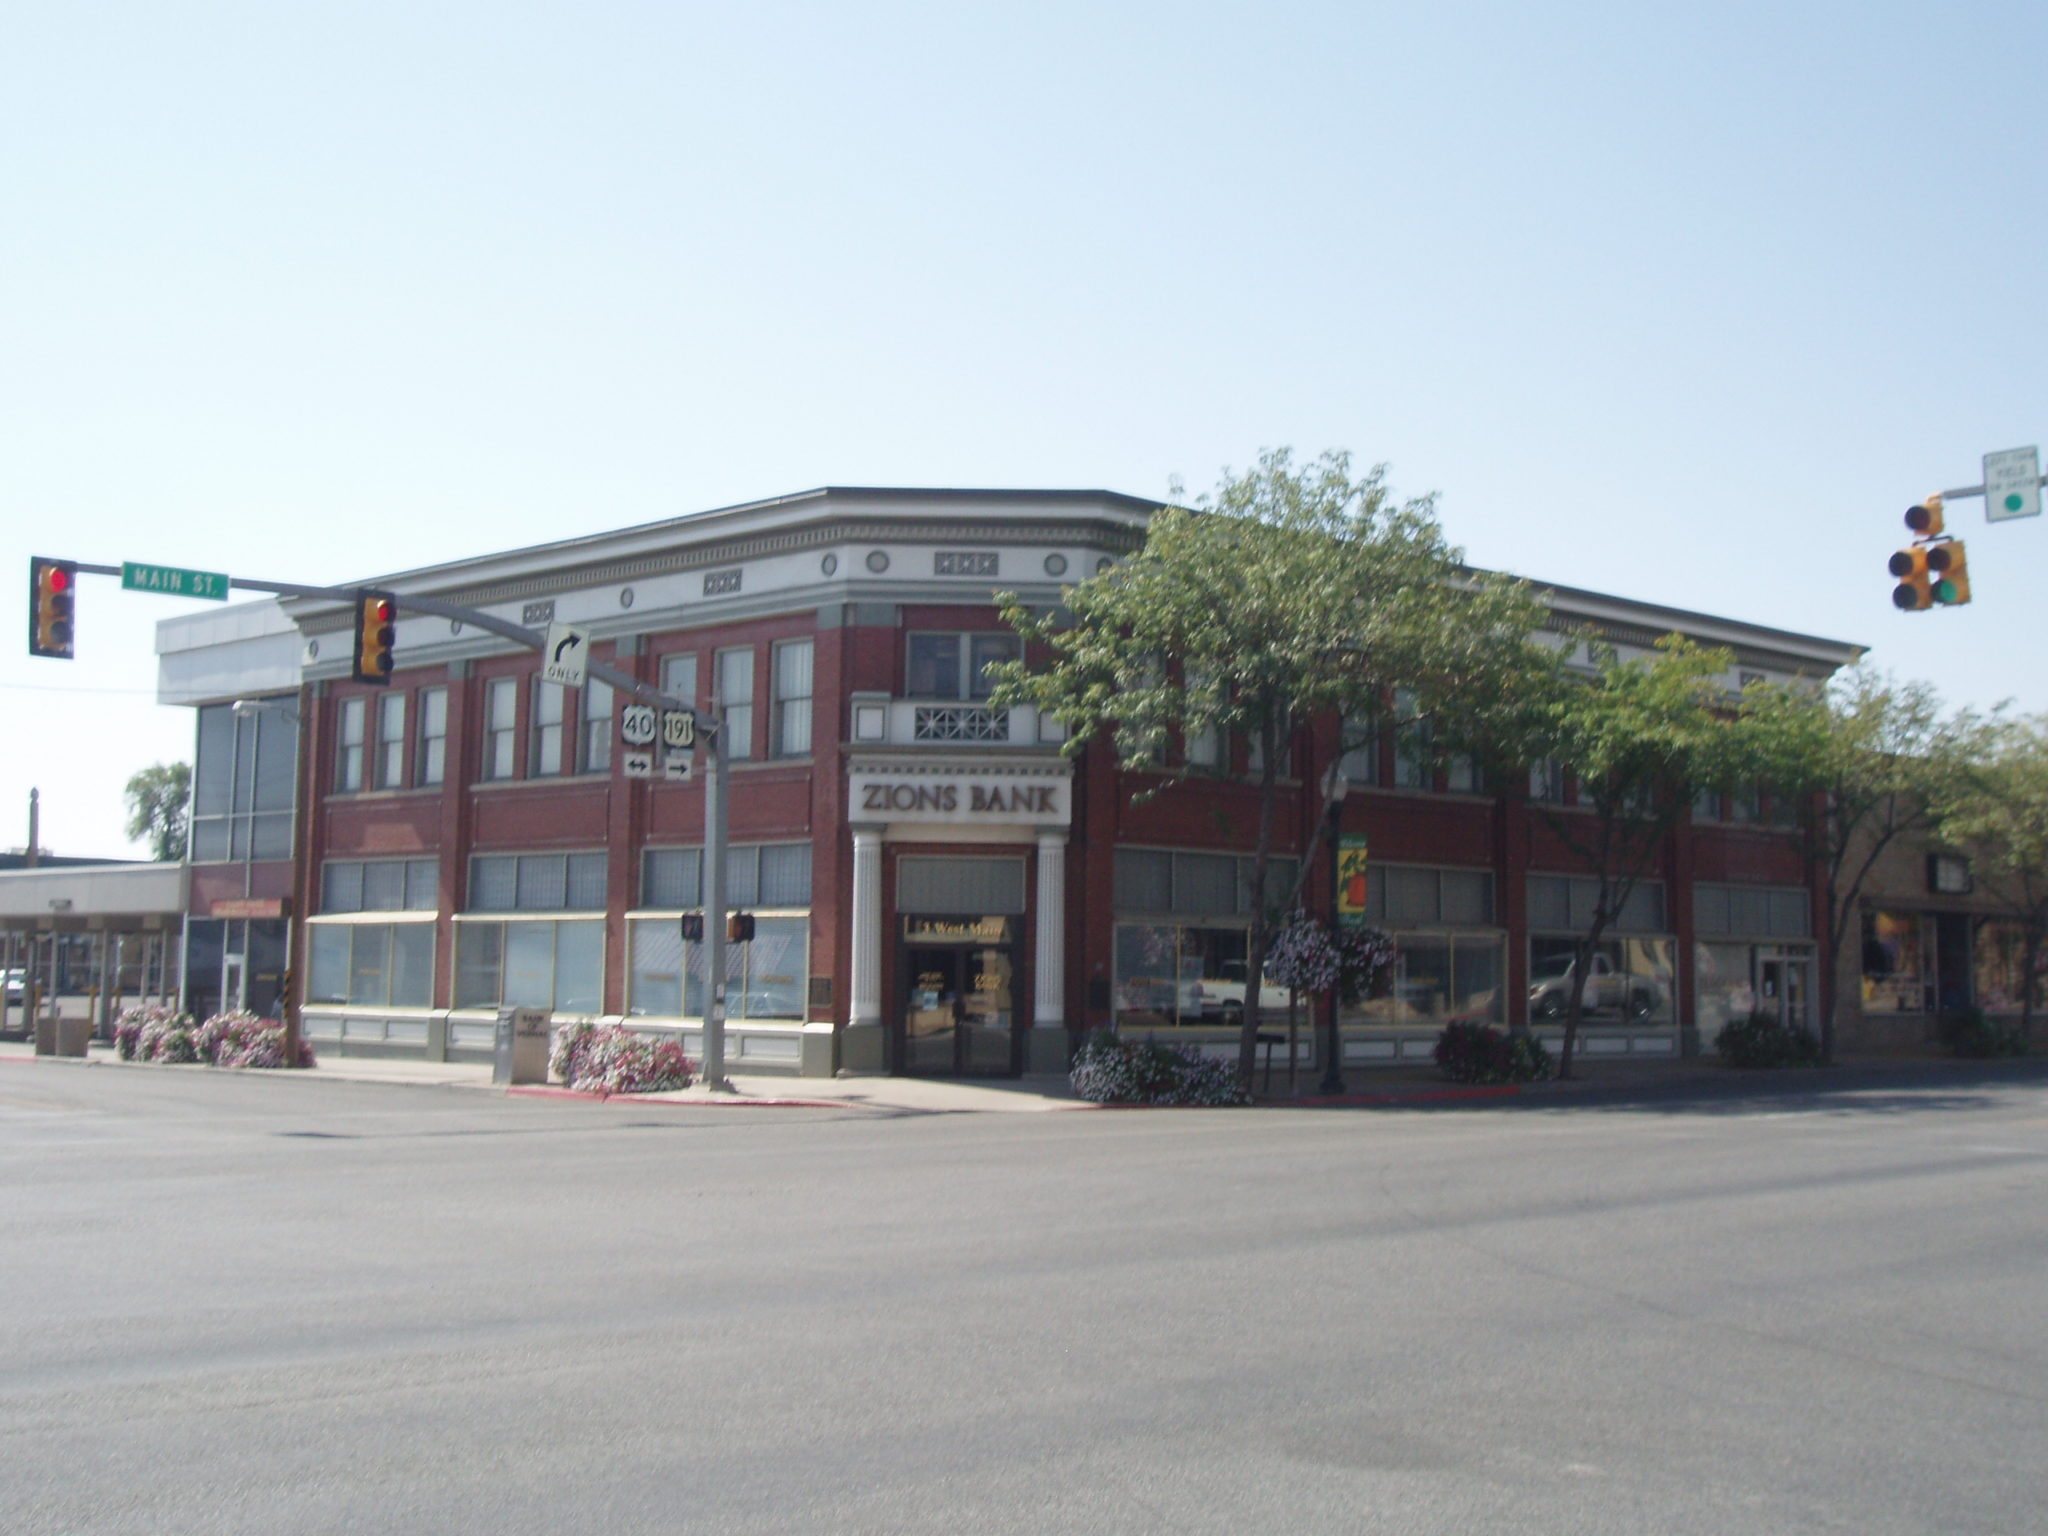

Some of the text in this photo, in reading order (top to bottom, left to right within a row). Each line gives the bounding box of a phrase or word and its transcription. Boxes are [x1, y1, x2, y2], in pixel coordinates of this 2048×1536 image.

[134, 567, 182, 592] MAIN
[548, 666, 579, 681] ONLY
[625, 714, 654, 736] 40
[668, 718, 690, 741] 191
[862, 784, 1058, 813] ZIONS BANK
[935, 920, 964, 935] West
